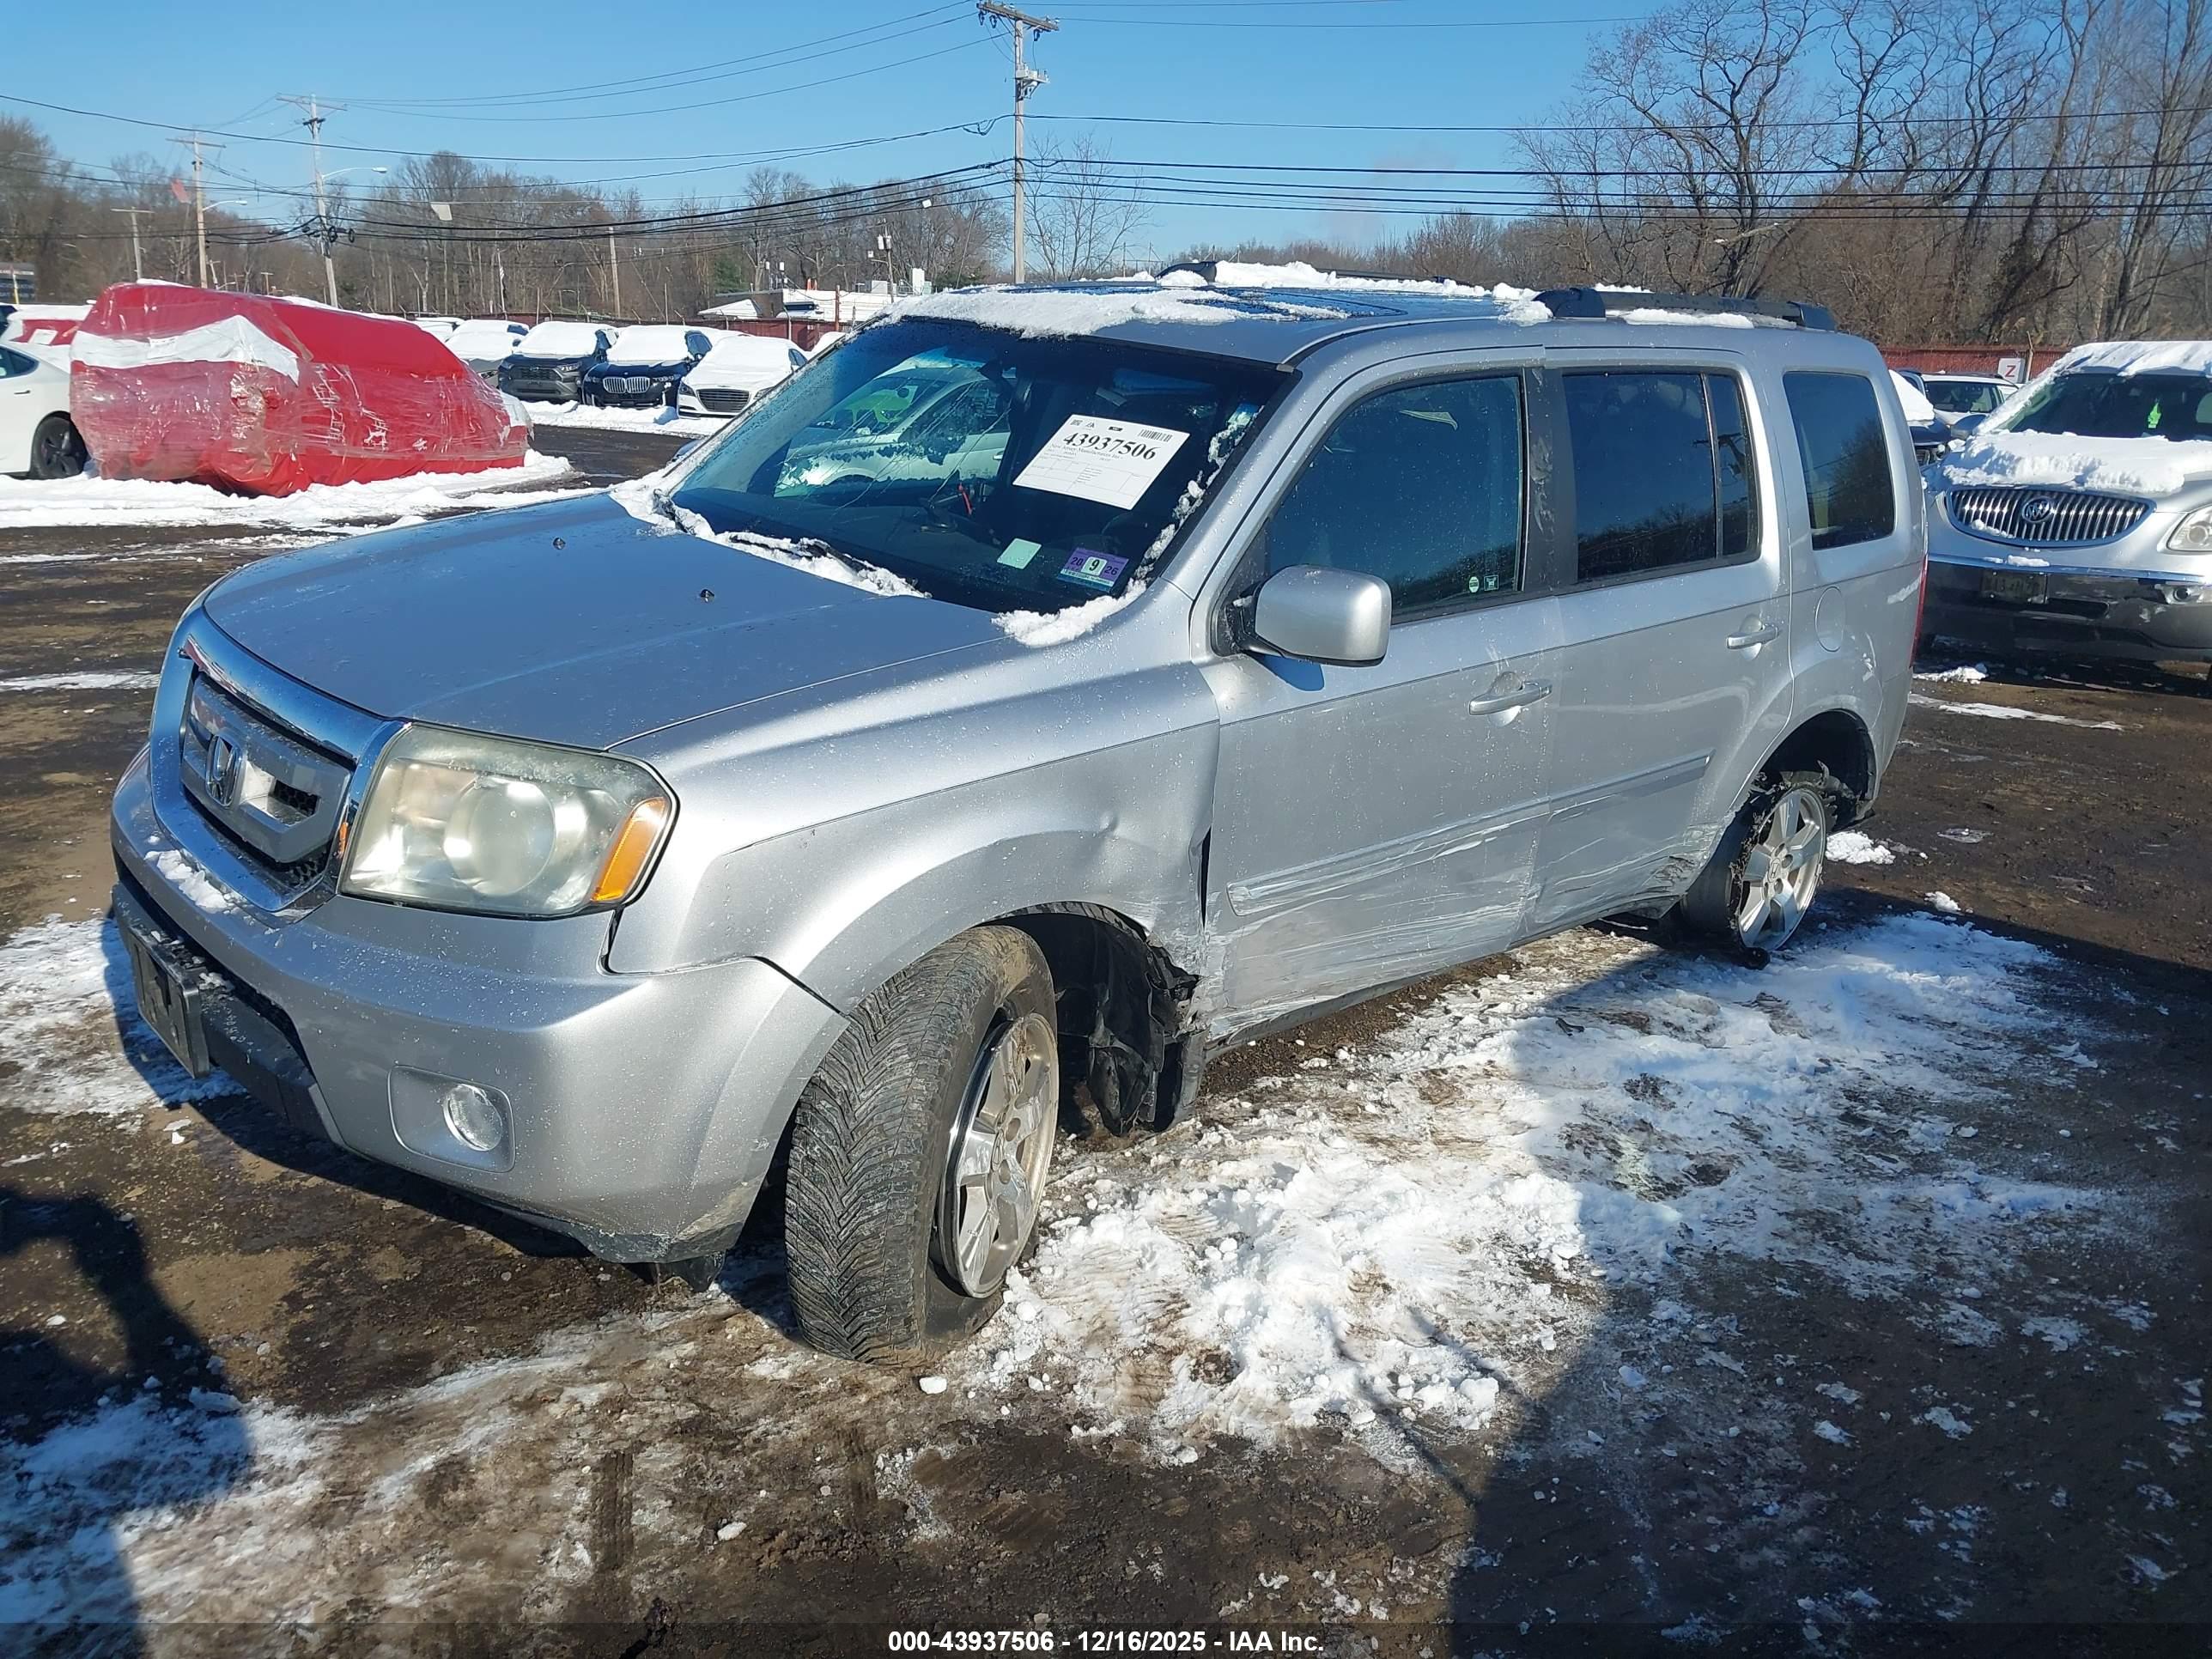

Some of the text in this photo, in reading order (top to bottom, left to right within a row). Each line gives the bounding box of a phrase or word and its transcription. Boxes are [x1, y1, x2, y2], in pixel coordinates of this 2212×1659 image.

[2005, 365, 2016, 378] Z
[1063, 432, 1161, 460] 43937506
[1070, 556, 1084, 566] 20
[1089, 559, 1100, 571] 9
[1104, 566, 1119, 575] 26
